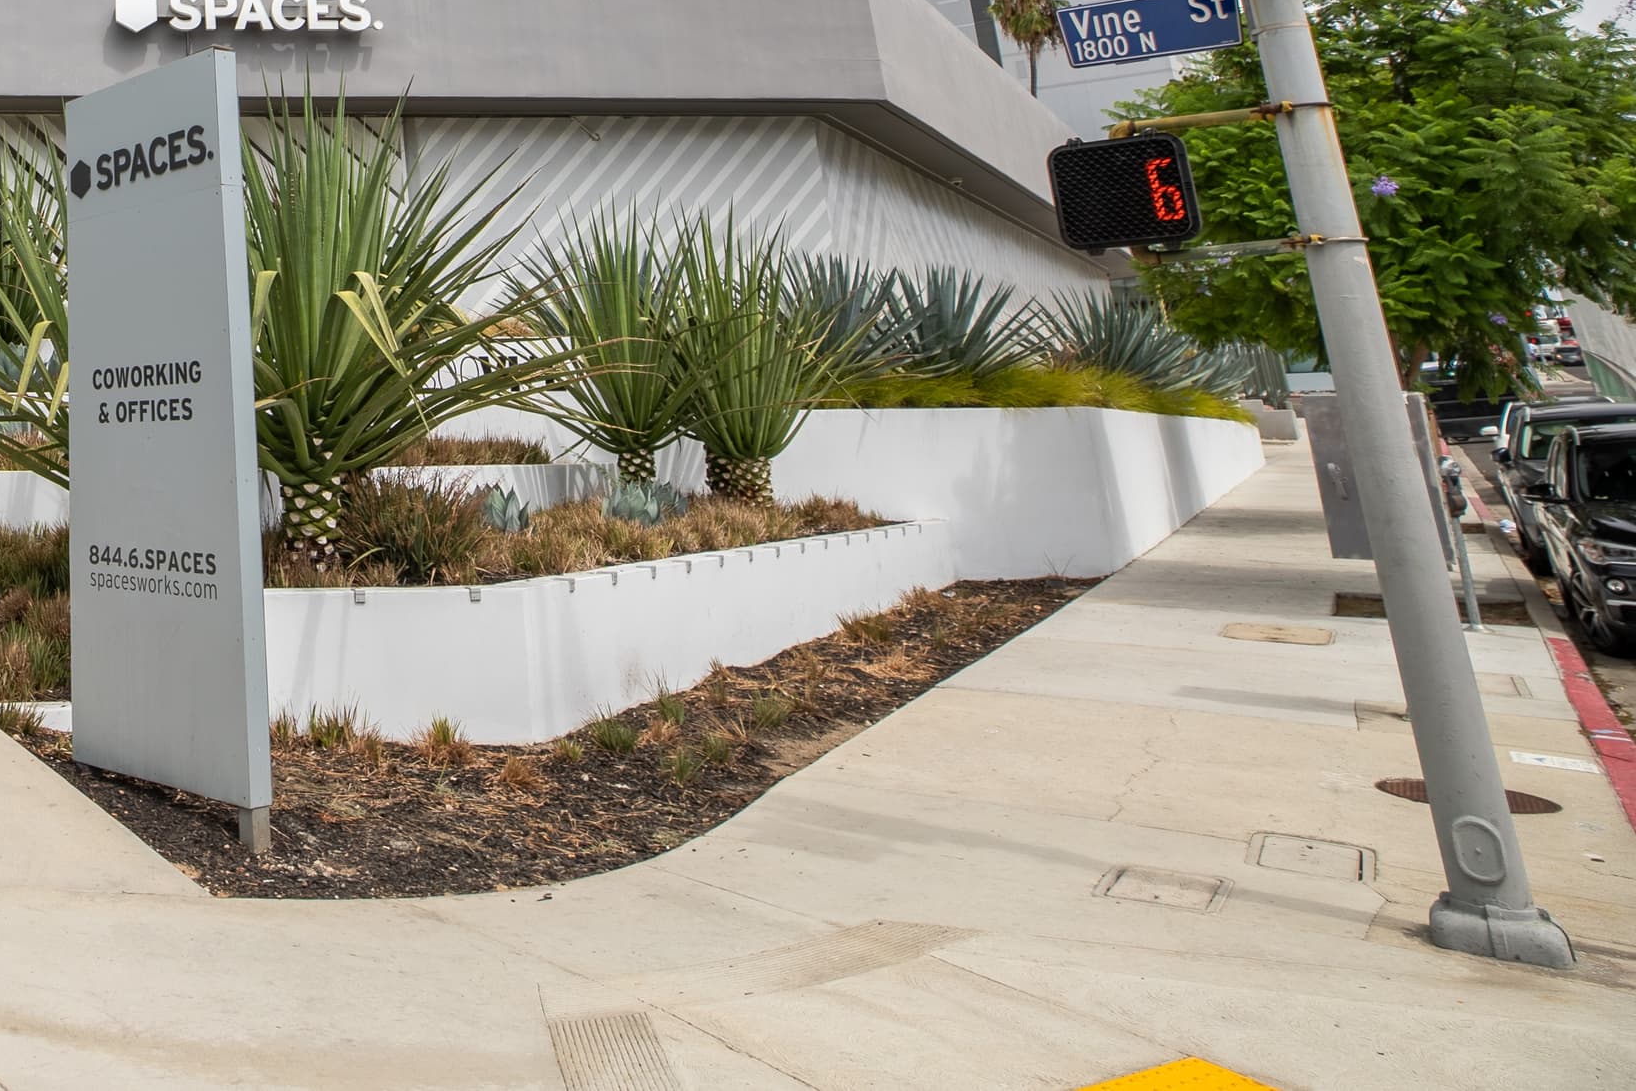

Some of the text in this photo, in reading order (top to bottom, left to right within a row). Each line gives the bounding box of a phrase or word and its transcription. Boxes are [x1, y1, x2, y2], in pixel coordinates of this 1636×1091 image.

[1069, 8, 1141, 39] Vine
[1075, 31, 1157, 61] 1800 N
[96, 125, 214, 190] SPACES.
[1146, 157, 1185, 221] 6
[92, 360, 202, 390] COWORKING
[98, 398, 193, 424] & OFFICES
[88, 544, 217, 575] 844.6.SPACES
[89, 571, 218, 601] spacesworks.com
